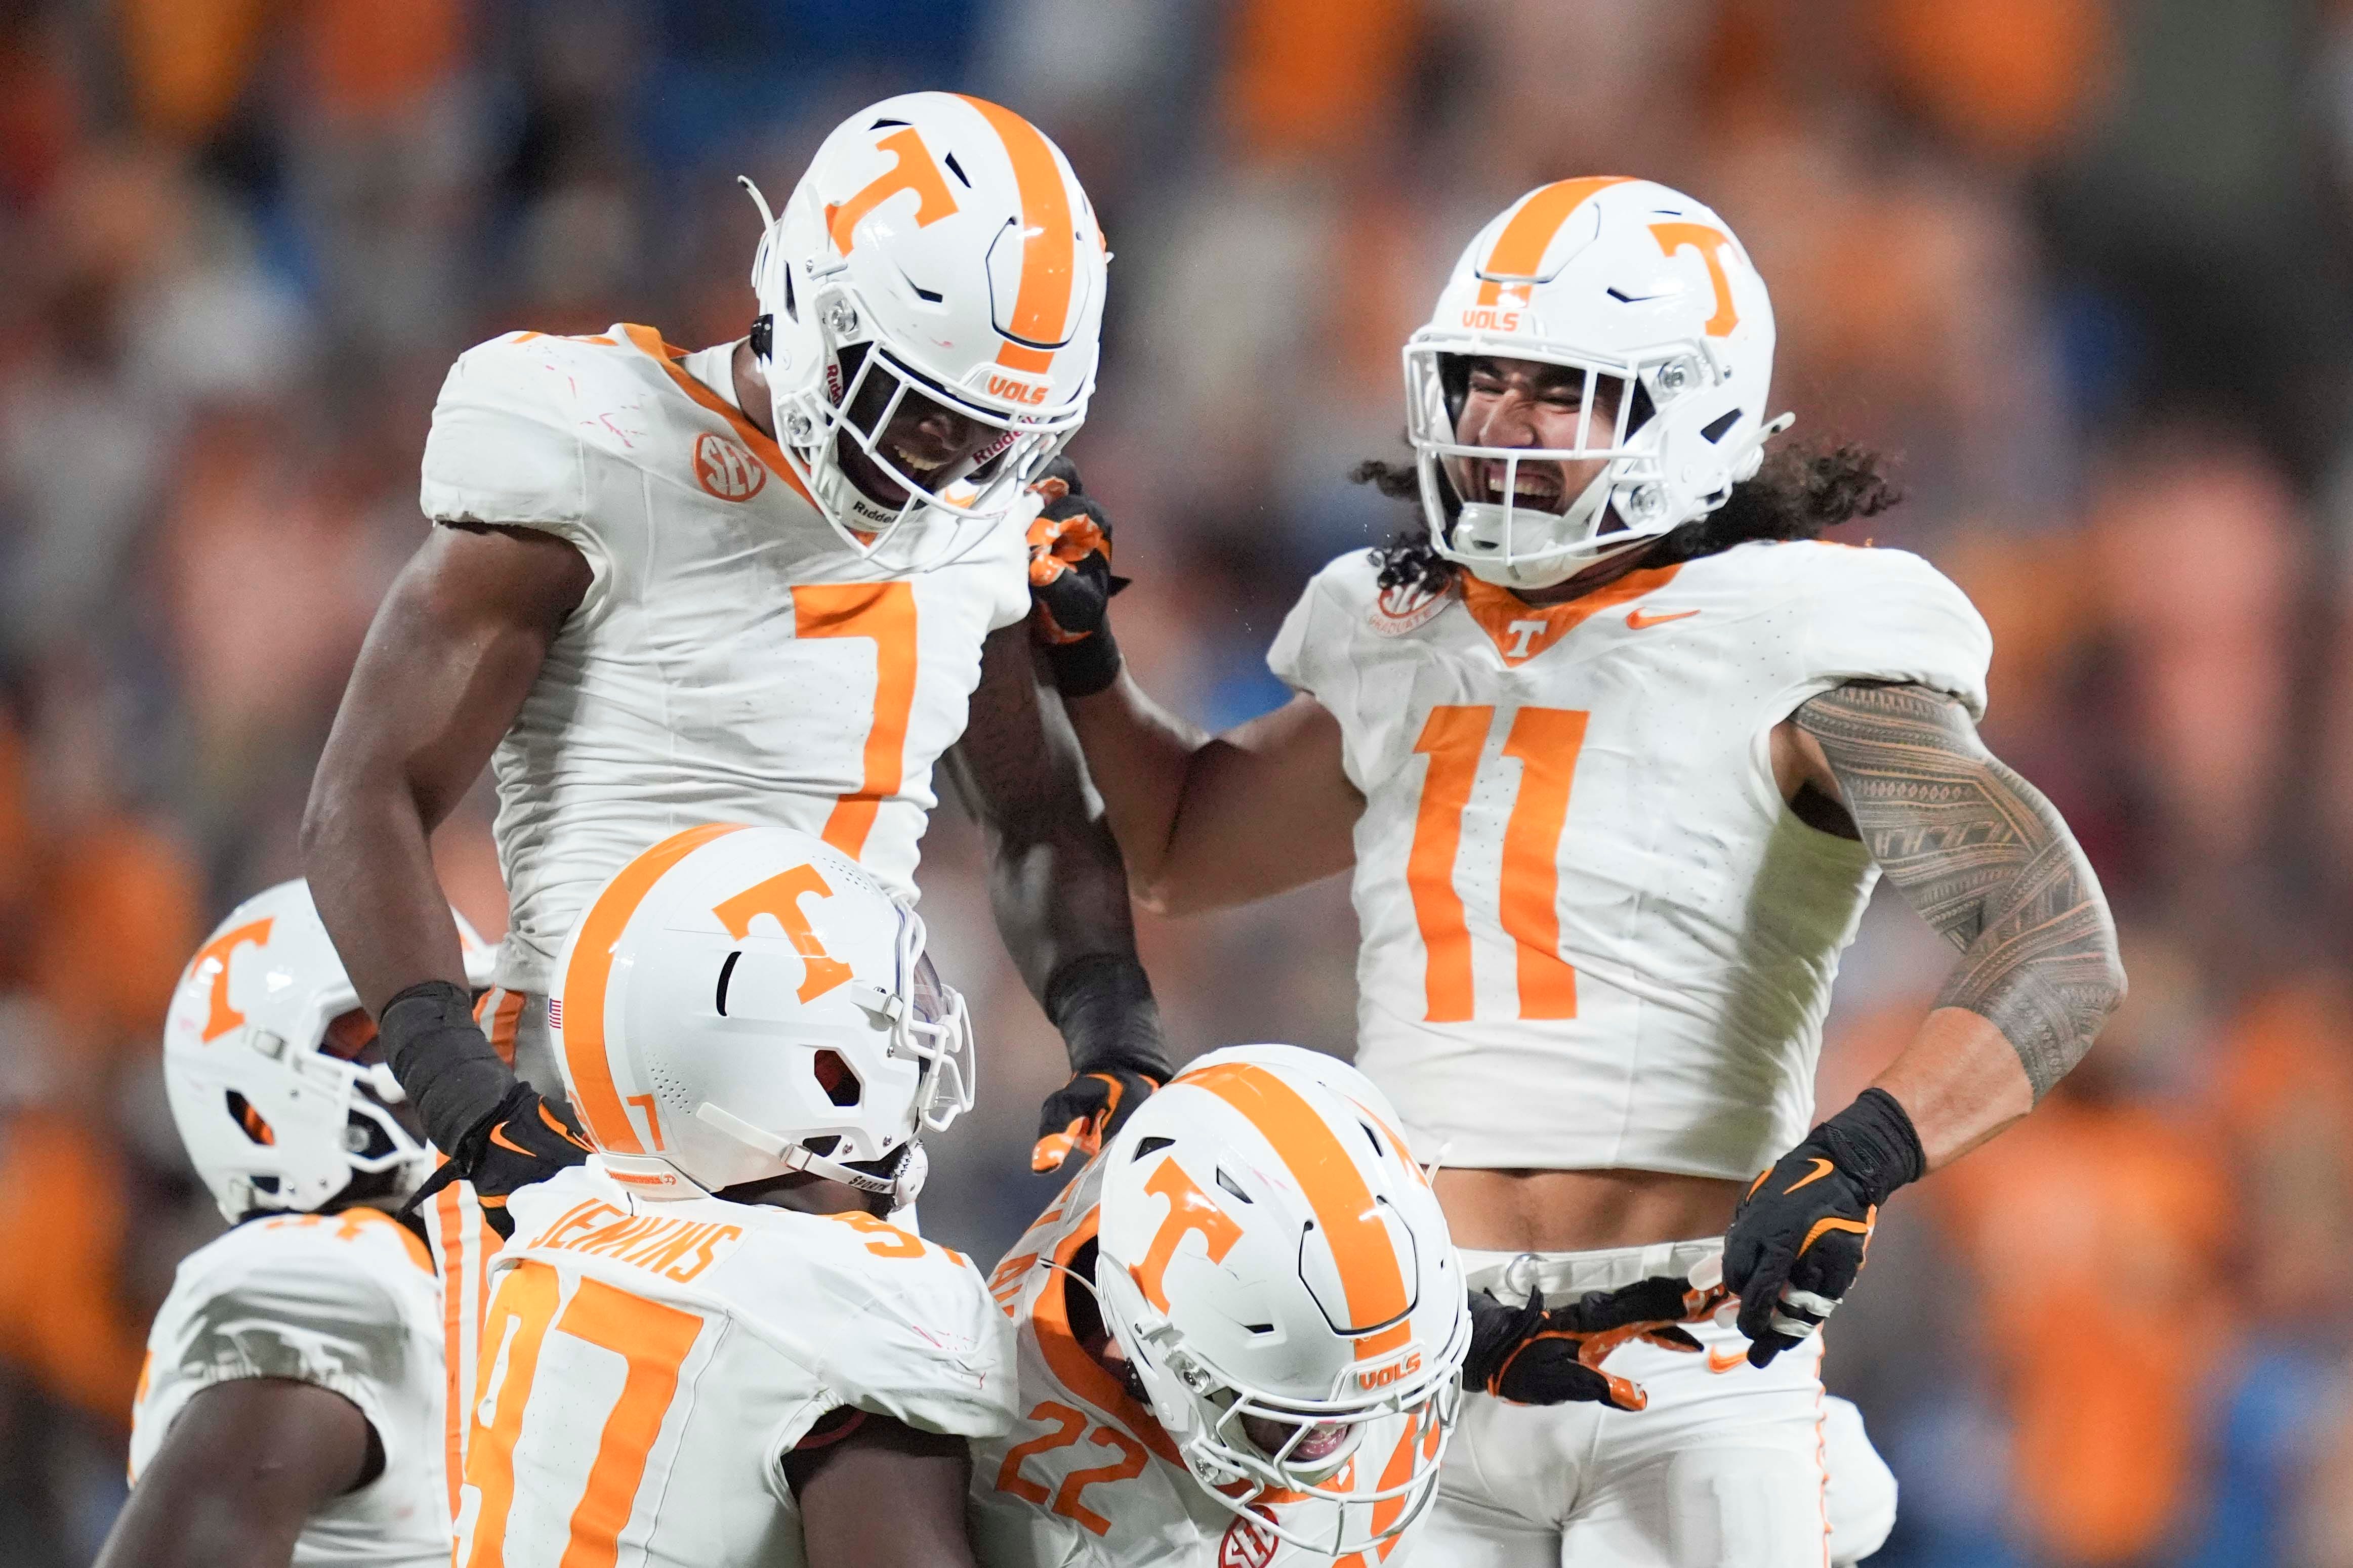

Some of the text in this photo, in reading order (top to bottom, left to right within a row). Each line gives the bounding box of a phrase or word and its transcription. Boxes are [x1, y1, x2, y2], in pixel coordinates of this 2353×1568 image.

[825, 127, 959, 258] T
[1462, 310, 1520, 332] VOLS
[1647, 223, 1742, 337] T
[988, 375, 1049, 405] VOLS
[698, 435, 763, 498] SEC
[853, 500, 899, 523] Riddel
[1507, 619, 1547, 658] T
[790, 581, 918, 862] 7
[1407, 705, 1590, 1023] 11
[192, 917, 275, 1043] T
[713, 863, 854, 1004] T
[526, 1198, 743, 1283] JENKINS
[1129, 1156, 1245, 1316] T
[451, 1258, 704, 1568] 97
[1359, 1352, 1422, 1391] VOLS
[994, 1400, 1150, 1537] 22
